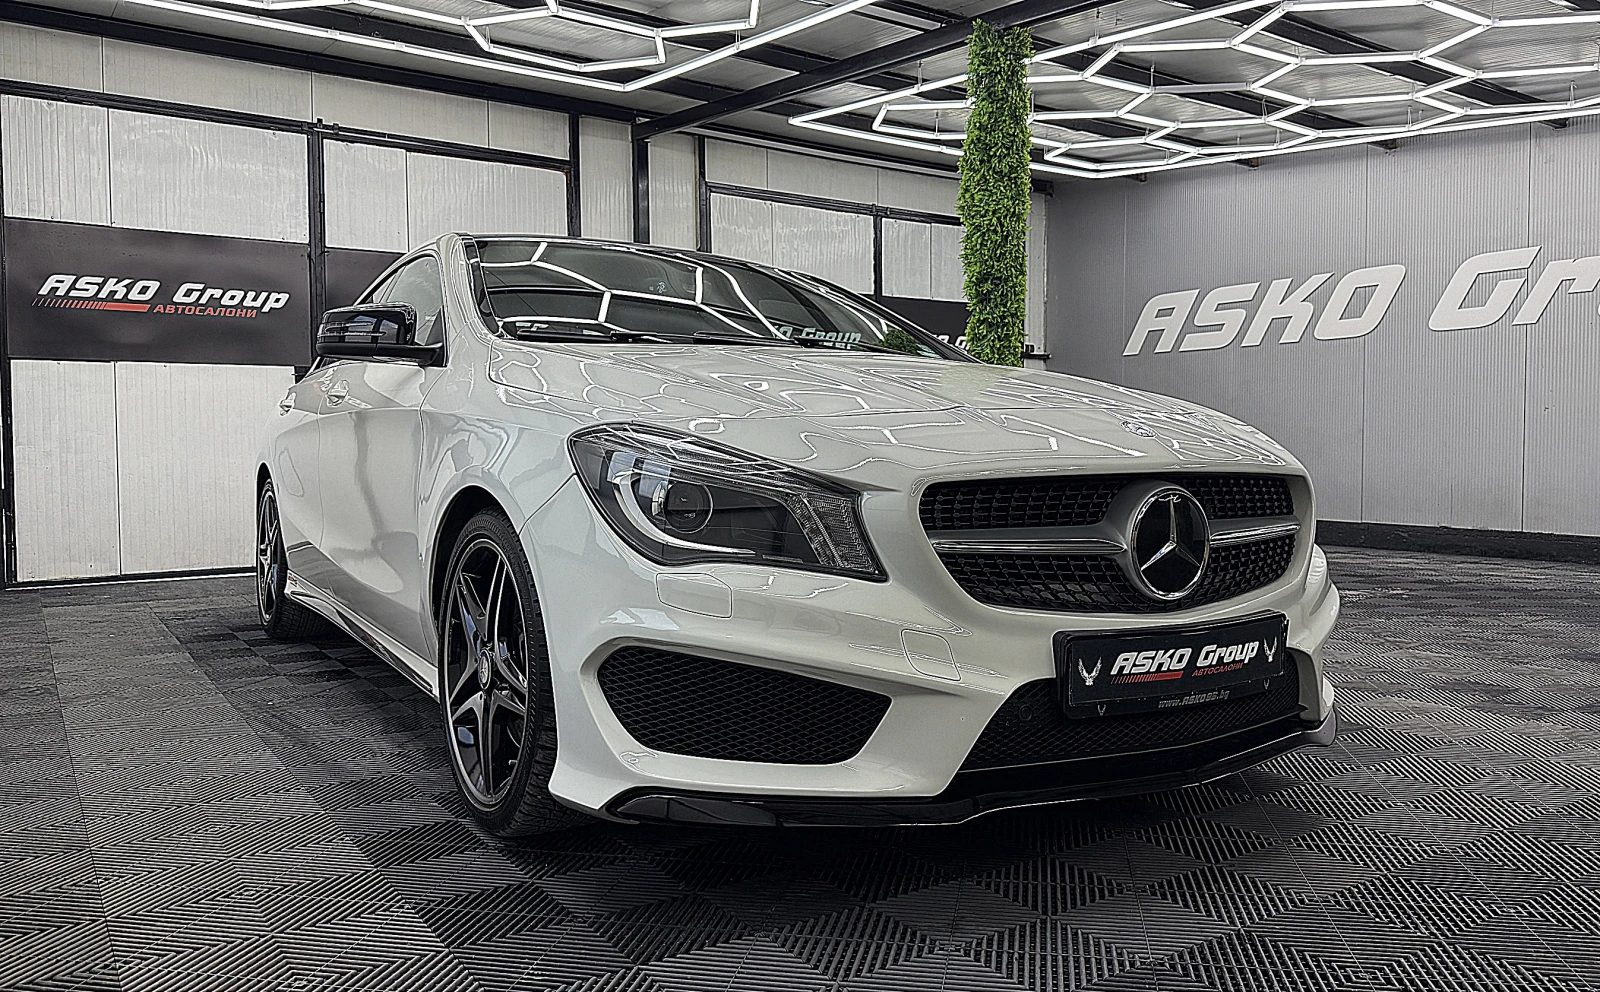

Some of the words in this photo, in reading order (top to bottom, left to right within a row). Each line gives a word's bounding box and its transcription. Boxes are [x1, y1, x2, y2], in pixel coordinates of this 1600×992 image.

[38, 274, 161, 300] ASKO
[173, 282, 290, 313] Group
[1123, 264, 1406, 356] ASKO
[1428, 246, 1600, 331] Gr
[153, 305, 258, 318] АВТОСАЛОНИ
[1110, 647, 1192, 675] ASKO
[1196, 641, 1259, 667] Group
[1191, 662, 1244, 677] АВТОСАЛОНИ
